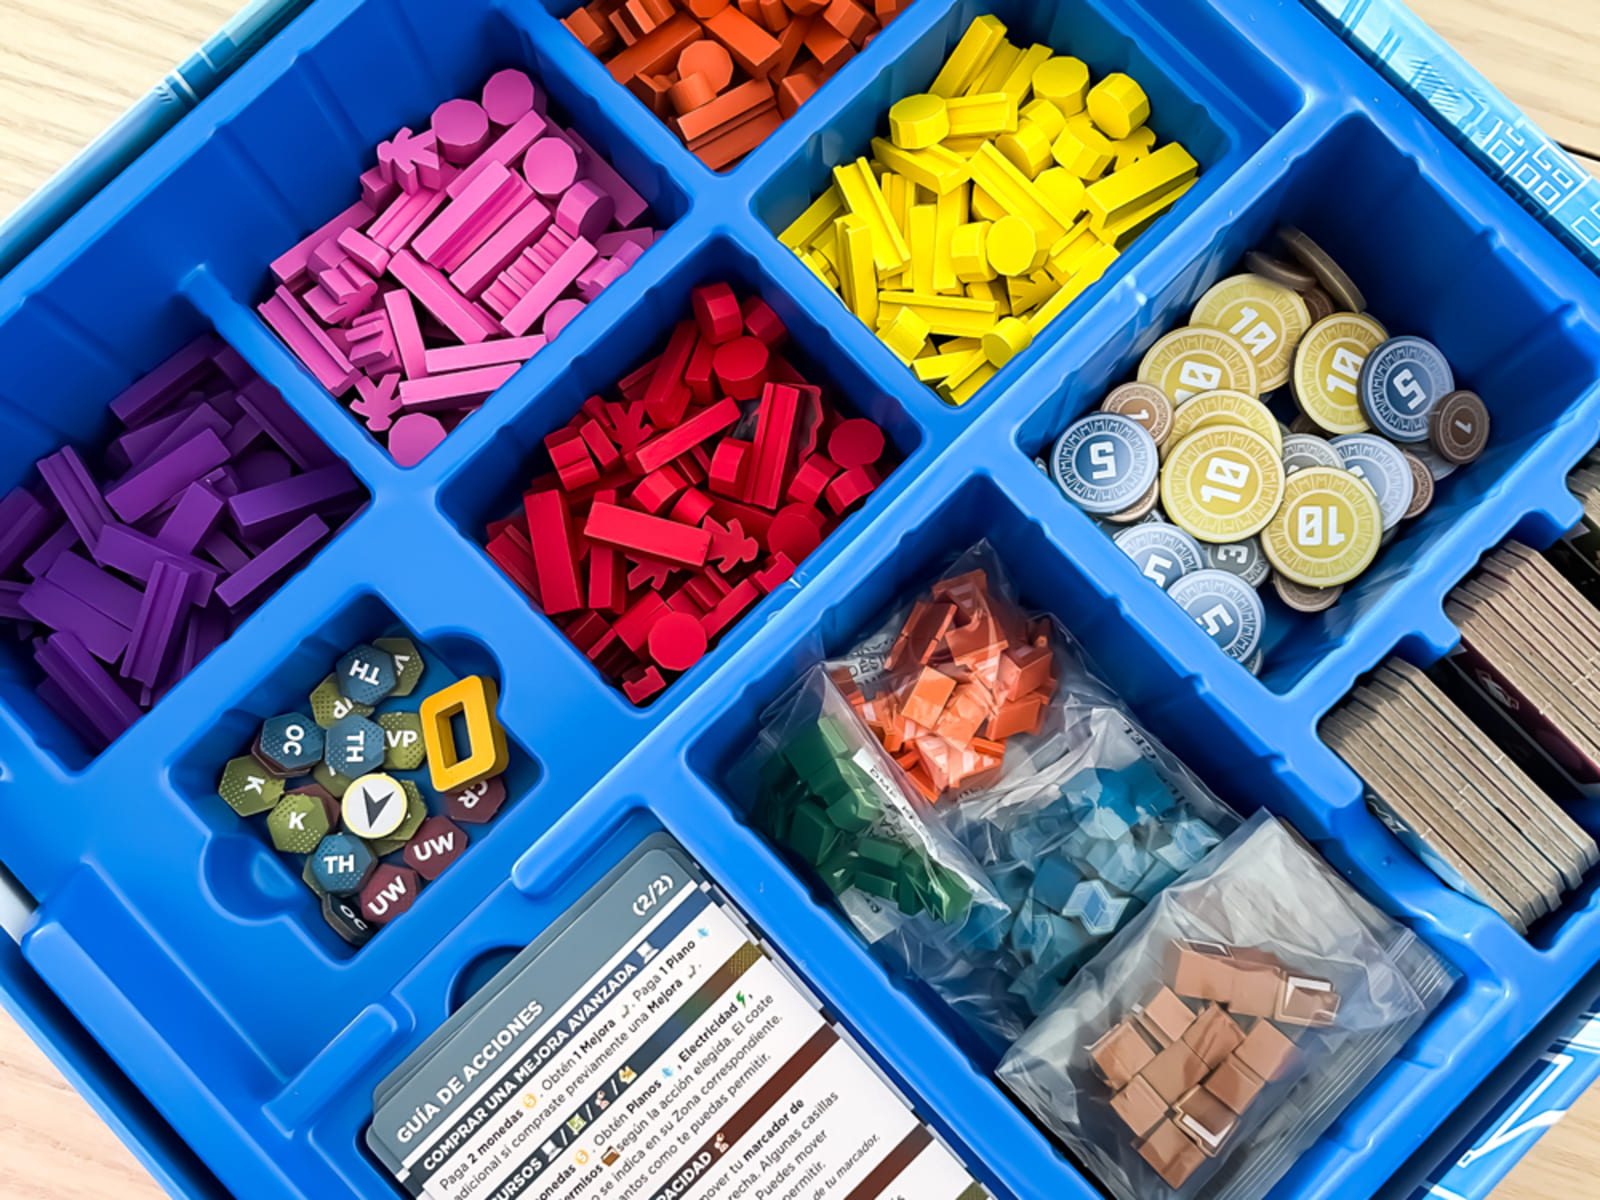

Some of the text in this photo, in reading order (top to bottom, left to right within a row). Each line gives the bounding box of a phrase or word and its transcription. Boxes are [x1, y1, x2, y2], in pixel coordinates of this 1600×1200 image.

[1229, 306, 1277, 357] 10
[1393, 368, 1427, 410] 5
[1454, 419, 1472, 434] 1
[1089, 441, 1117, 480] 5
[1200, 457, 1250, 503] 10
[1298, 505, 1345, 546] 10
[1217, 544, 1248, 564] 3
[349, 659, 380, 686] TH
[282, 724, 305, 756] OC
[346, 730, 365, 762] TH
[386, 730, 418, 748] VP
[244, 775, 265, 795] K
[288, 811, 308, 830] K
[323, 854, 354, 874] TH
[413, 831, 454, 861] UW
[367, 875, 407, 915] UW
[632, 874, 674, 916] (2/2)
[340, 904, 368, 930] OC
[397, 1000, 543, 1143] GUÍA DE ACCIONES
[423, 963, 637, 1170] COMPRAR UNA MEJORA AVANZADA
[439, 1162, 470, 1191] Paga
[467, 1152, 478, 1164] 2
[477, 1109, 524, 1156] monedas
[541, 1057, 577, 1091] Obtén
[580, 1018, 616, 1055] Mejora
[632, 974, 662, 1001] Paga
[665, 939, 696, 970] Plano
[500, 1144, 513, 1159] si
[511, 1093, 566, 1148] compraste
[565, 1031, 629, 1097] previamente
[628, 1012, 649, 1033] una
[647, 978, 683, 1013] Mejora
[616, 1117, 649, 1152] según
[646, 1106, 660, 1122] la
[660, 1076, 694, 1111] acción
[693, 1037, 735, 1076] elegida.
[731, 1020, 746, 1036] El
[746, 994, 774, 1024] coste
[593, 1111, 628, 1146] Obtén
[625, 1079, 662, 1114] Planos
[599, 1014, 783, 1196] se indica en su Zona correspondiente.
[648, 1144, 678, 1175] como
[676, 1131, 691, 1145] te
[690, 1092, 729, 1134] puedas
[728, 1055, 771, 1097] permitir.
[729, 1160, 744, 1174] tu
[743, 1114, 790, 1162] marcador
[789, 1098, 805, 1117] de
[760, 1128, 802, 1172] Algunas
[801, 1090, 839, 1130] casillas
[794, 1128, 828, 1164] mover
[491, 1158, 542, 1200] URSOS
[825, 1176, 837, 1189] tu
[836, 1134, 881, 1179] marcador.
